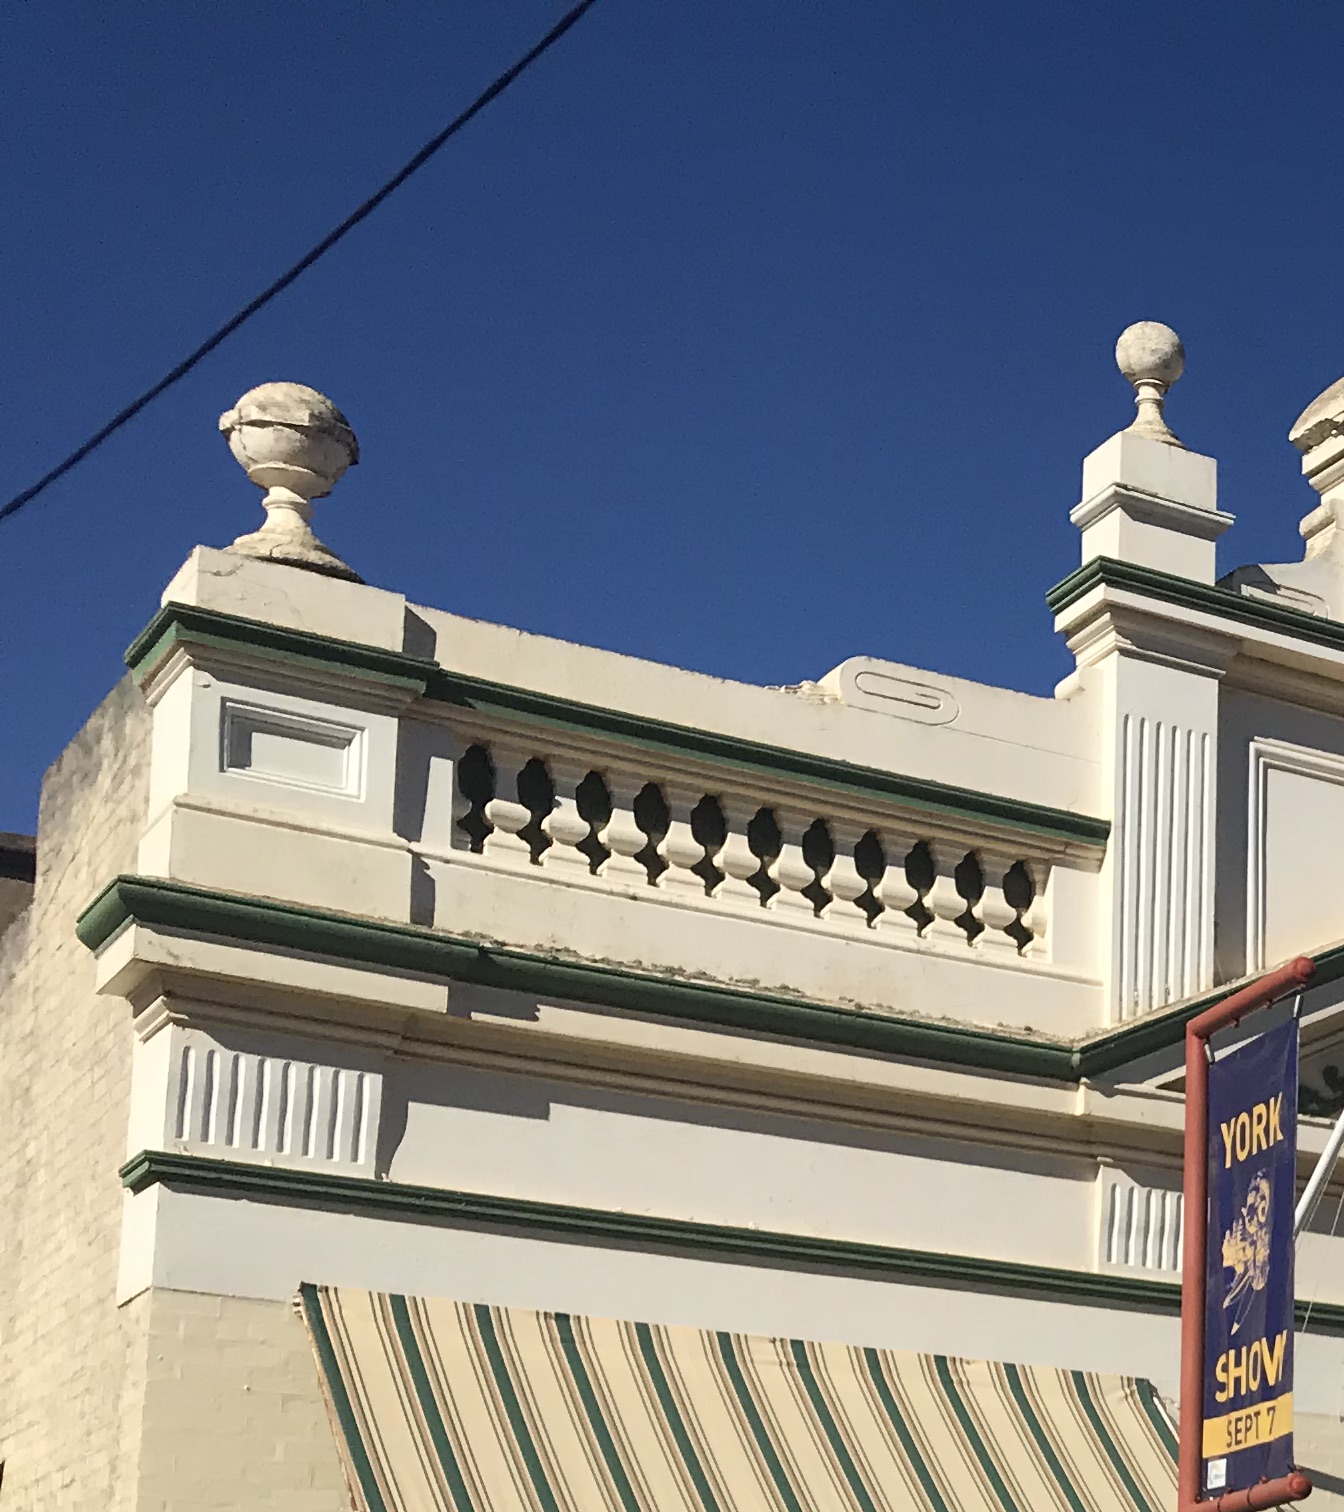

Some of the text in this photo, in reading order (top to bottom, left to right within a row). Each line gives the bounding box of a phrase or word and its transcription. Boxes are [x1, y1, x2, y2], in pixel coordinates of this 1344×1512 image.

[1220, 1091, 1284, 1169] YORK
[1215, 1329, 1287, 1403] SHOW
[1226, 1405, 1276, 1449] SEPT 7
